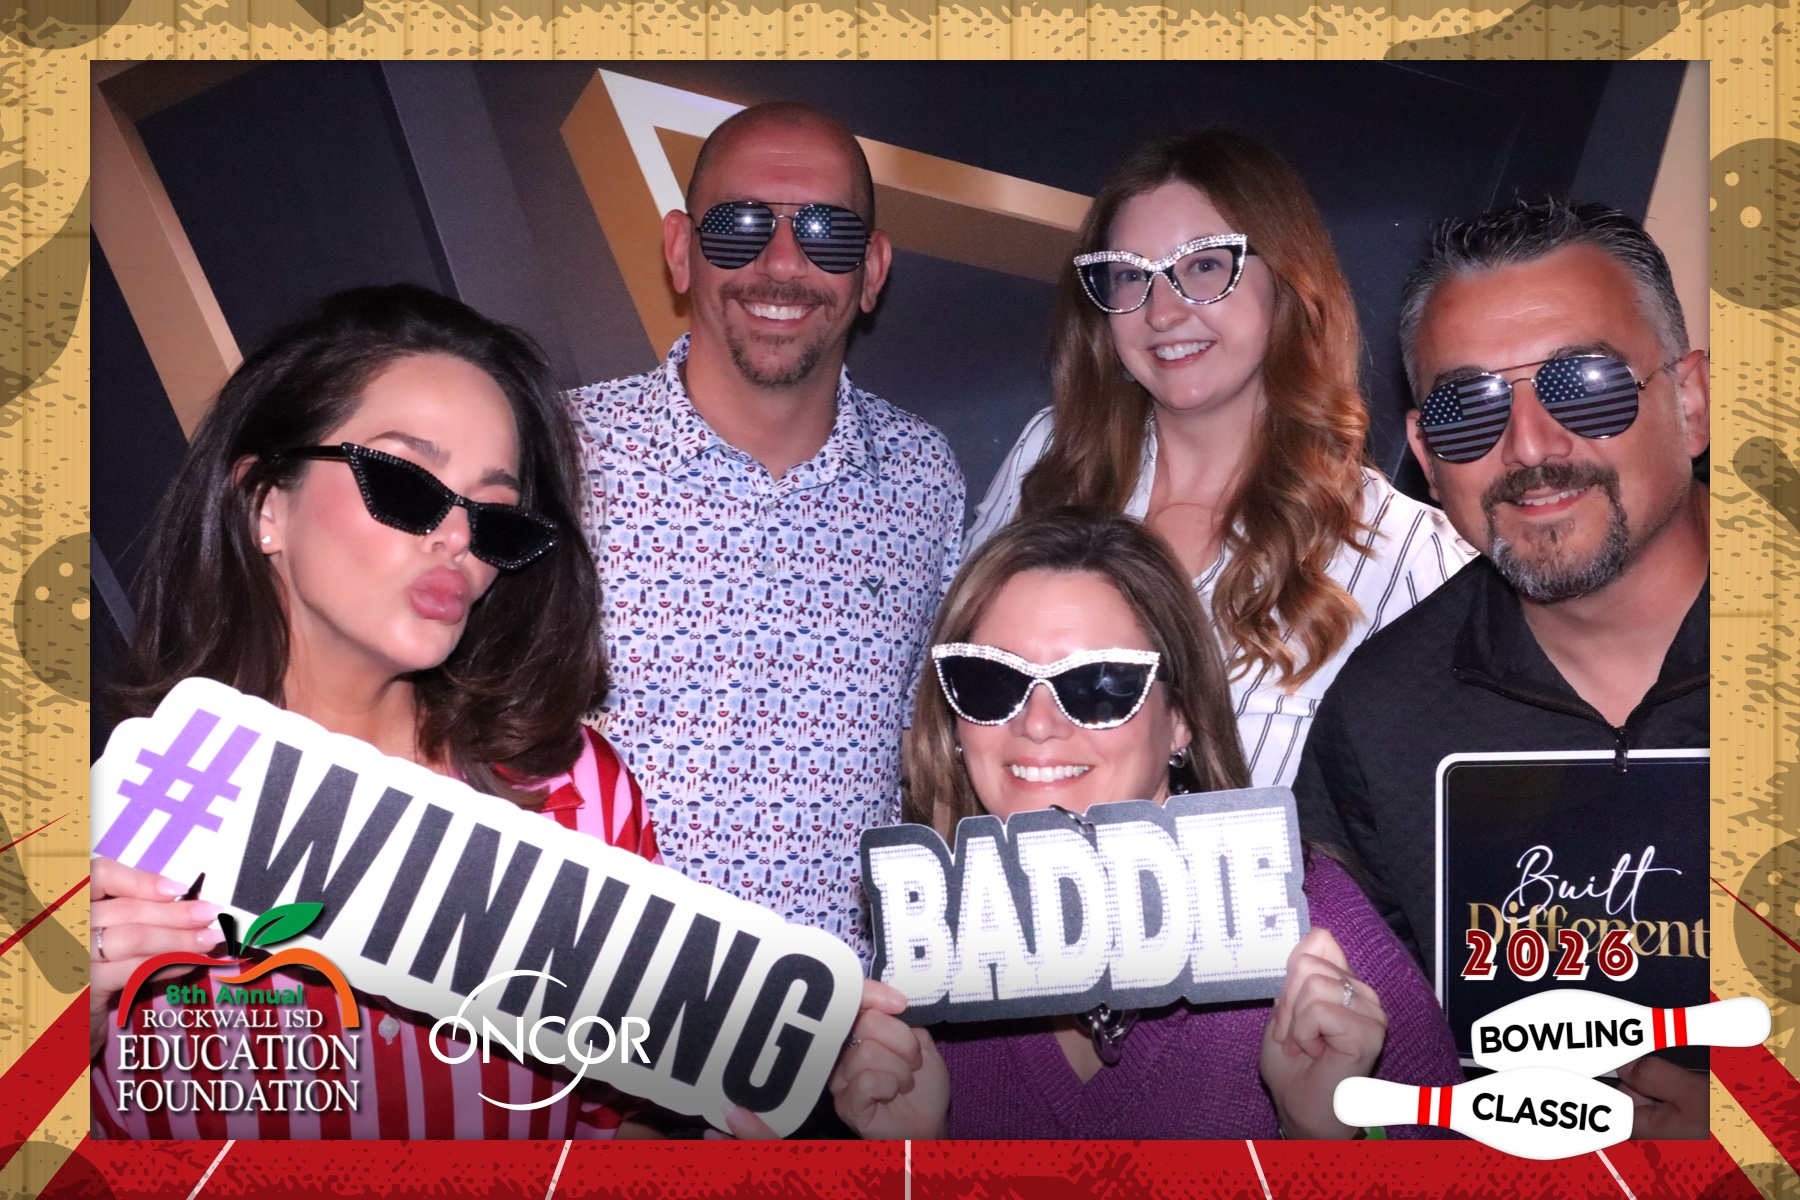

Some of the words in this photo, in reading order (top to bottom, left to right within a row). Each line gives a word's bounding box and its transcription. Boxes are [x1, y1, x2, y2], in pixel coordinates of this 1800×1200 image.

[93, 709, 836, 1114] #WINNING
[869, 806, 1300, 1007] BADDIE
[1501, 845, 1682, 924] Built
